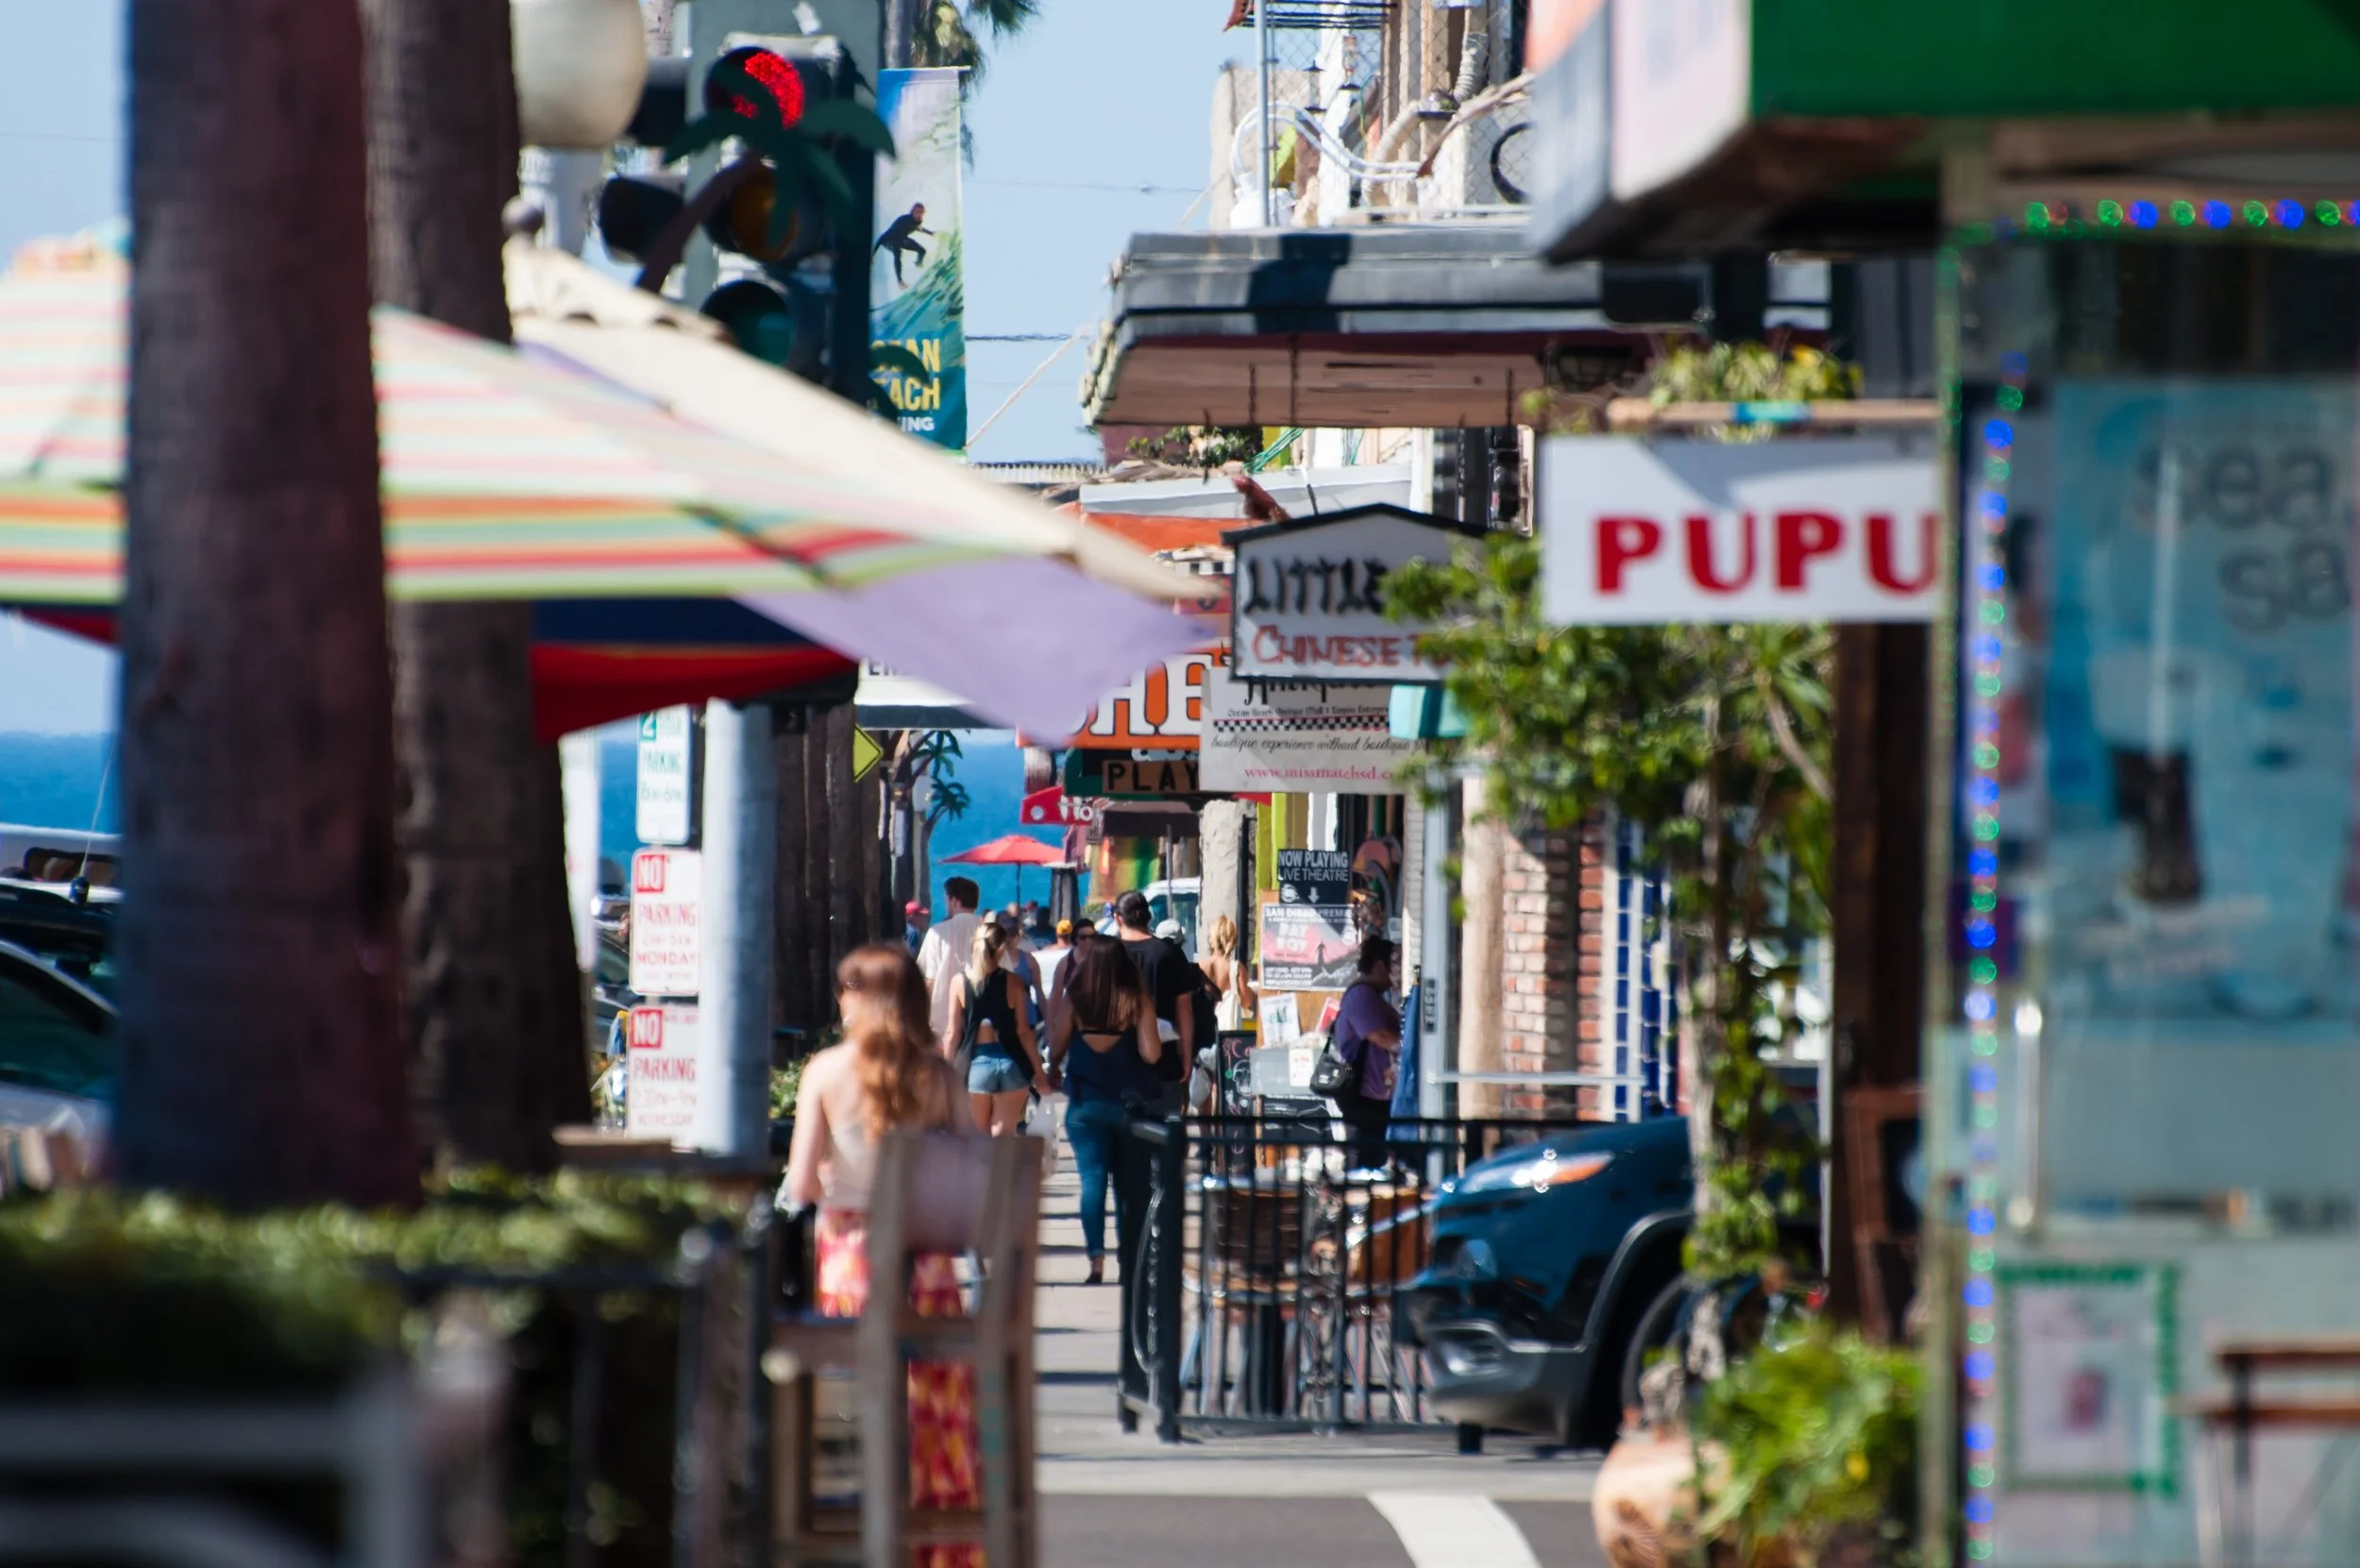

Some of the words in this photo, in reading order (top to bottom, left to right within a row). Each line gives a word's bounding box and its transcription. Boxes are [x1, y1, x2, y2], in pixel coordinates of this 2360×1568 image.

[1592, 510, 1941, 596] PUPU
[1253, 624, 1401, 667] CHINESE
[1107, 760, 1200, 792] PLAY
[638, 855, 663, 889] NO
[1278, 851, 1302, 867] NOW
[1305, 851, 1348, 868] PLAYING
[1278, 868, 1302, 881] LIVE
[1303, 868, 1348, 882] THEATRE
[638, 902, 698, 926] PARKING
[635, 950, 698, 965] MONDAY
[633, 1012, 659, 1045] NO
[632, 1056, 697, 1082] PARKING
